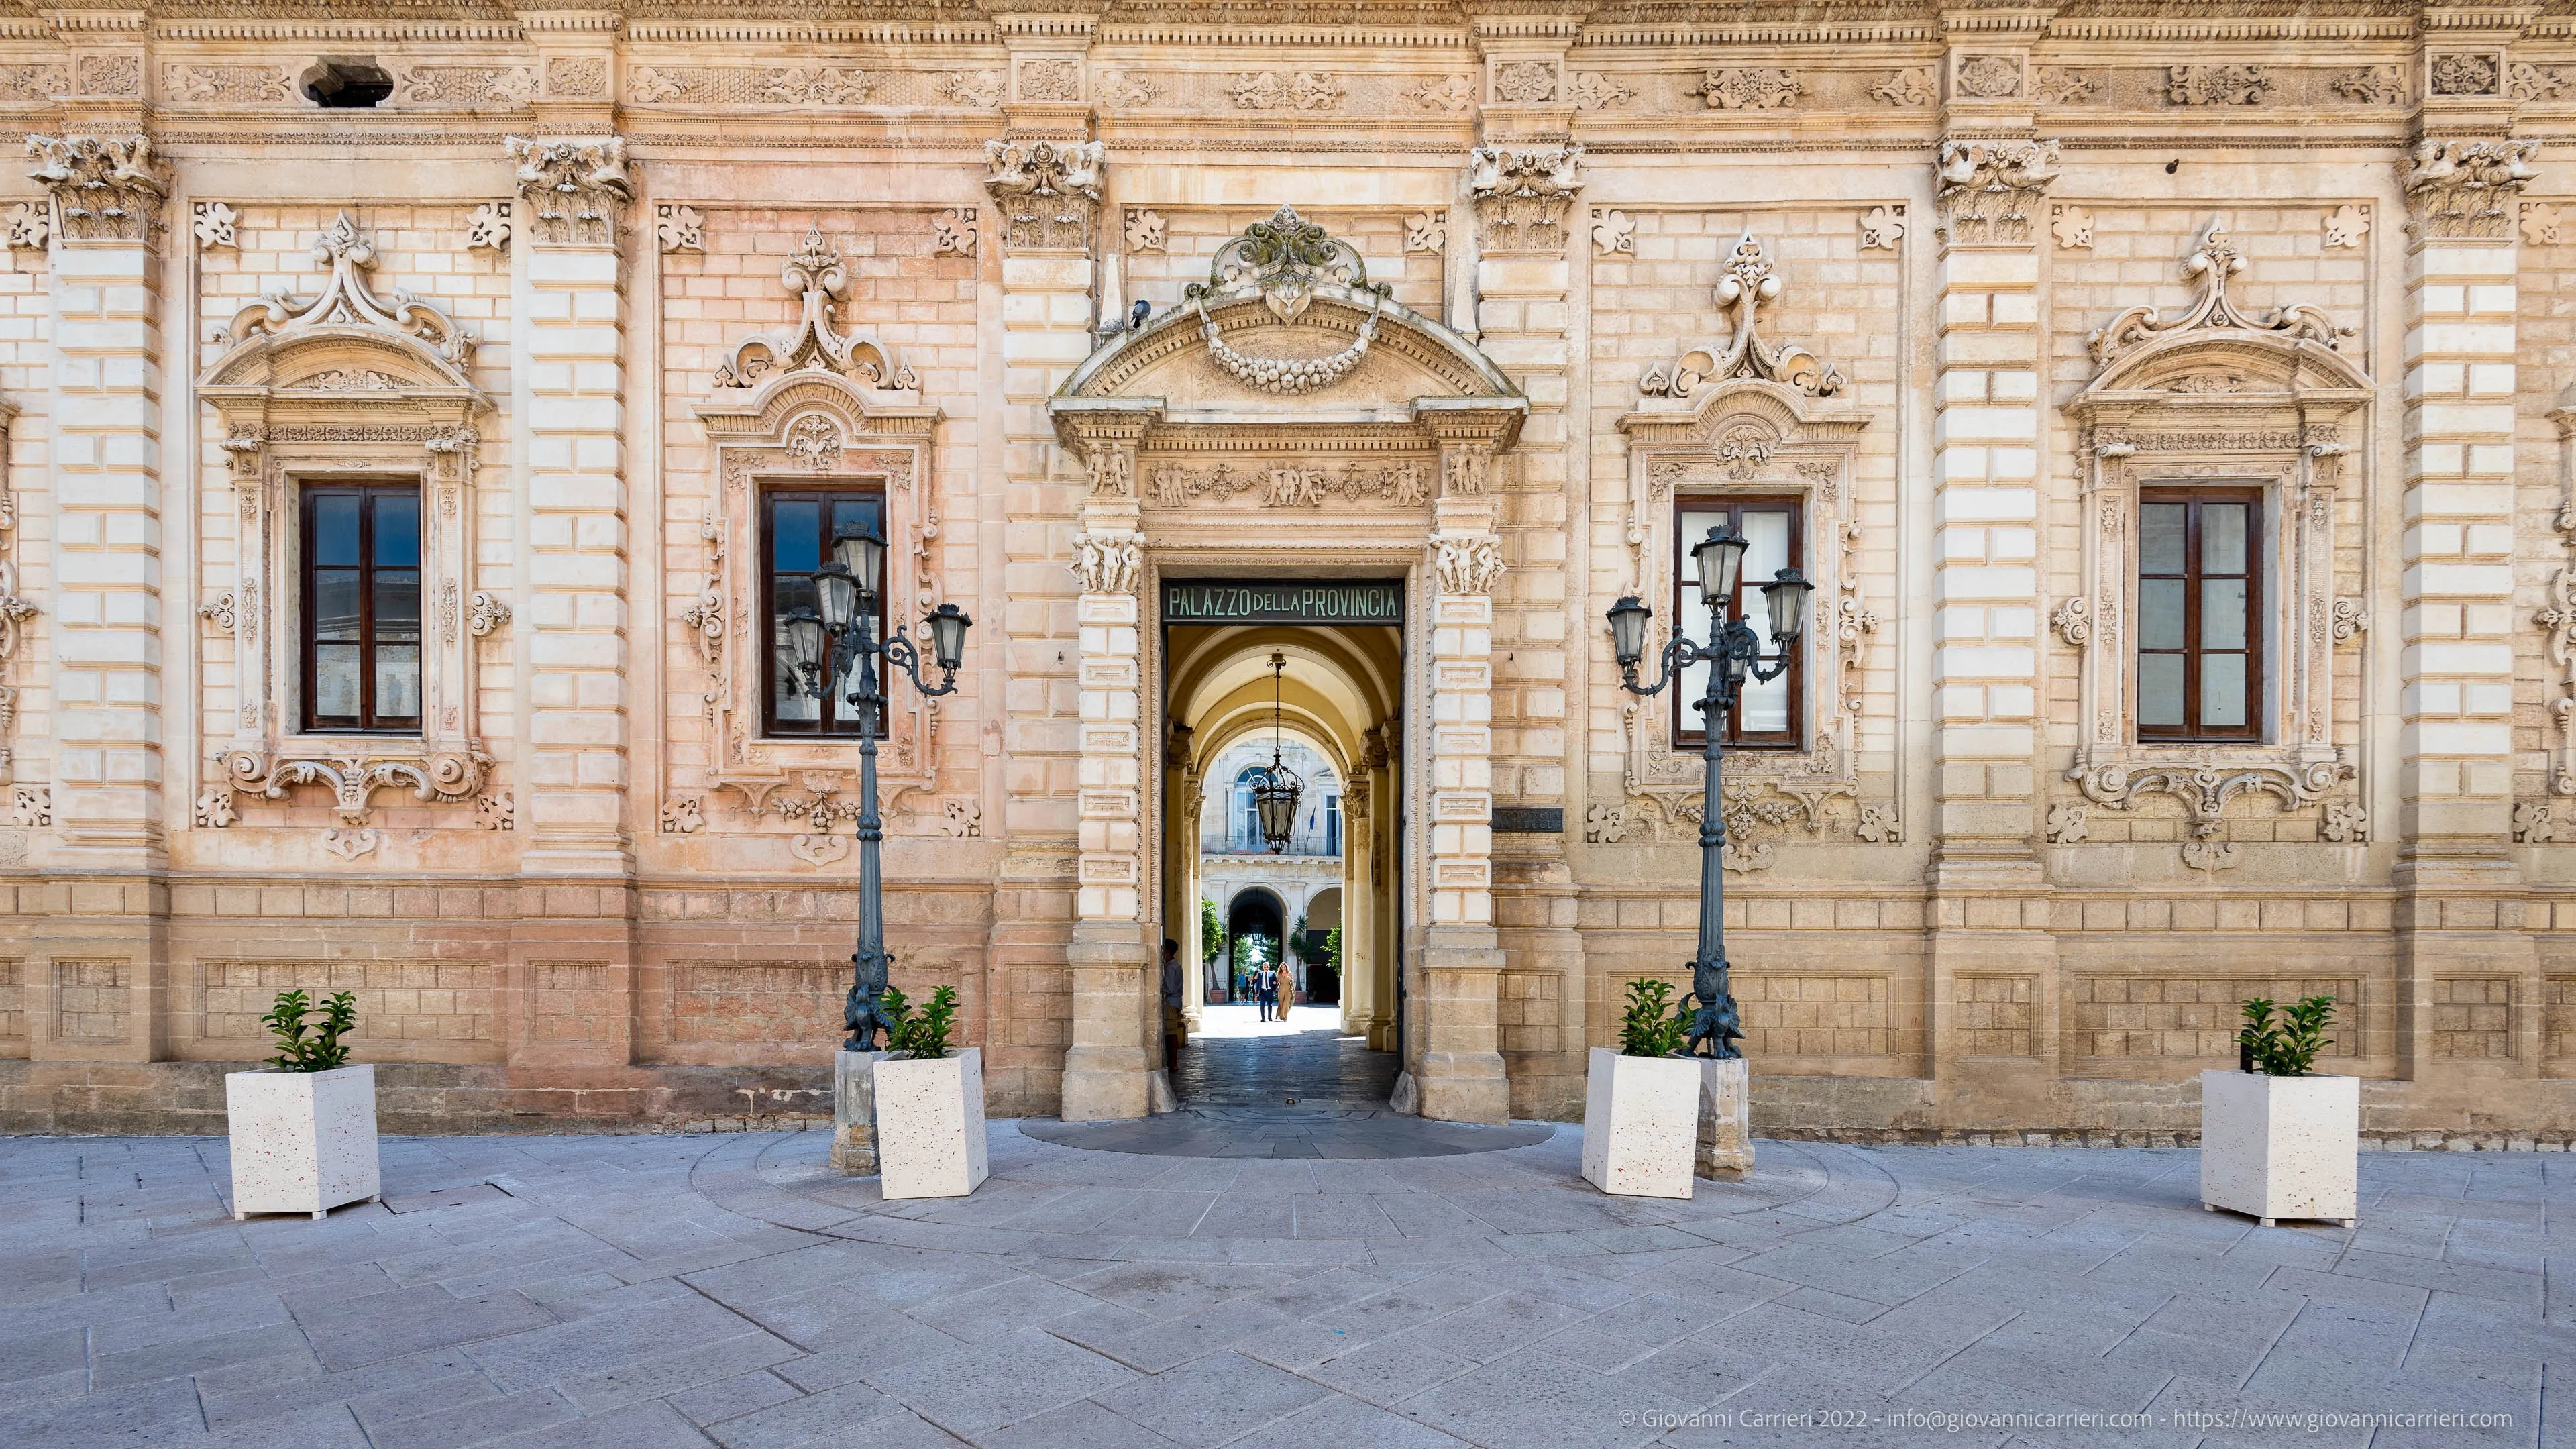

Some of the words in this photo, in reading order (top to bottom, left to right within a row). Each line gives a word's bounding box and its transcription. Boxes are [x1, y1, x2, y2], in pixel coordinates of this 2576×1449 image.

[1169, 588, 1251, 616] PALAZZO
[1252, 594, 1301, 612] DELLA
[1302, 588, 1397, 616] PROVINCIA
